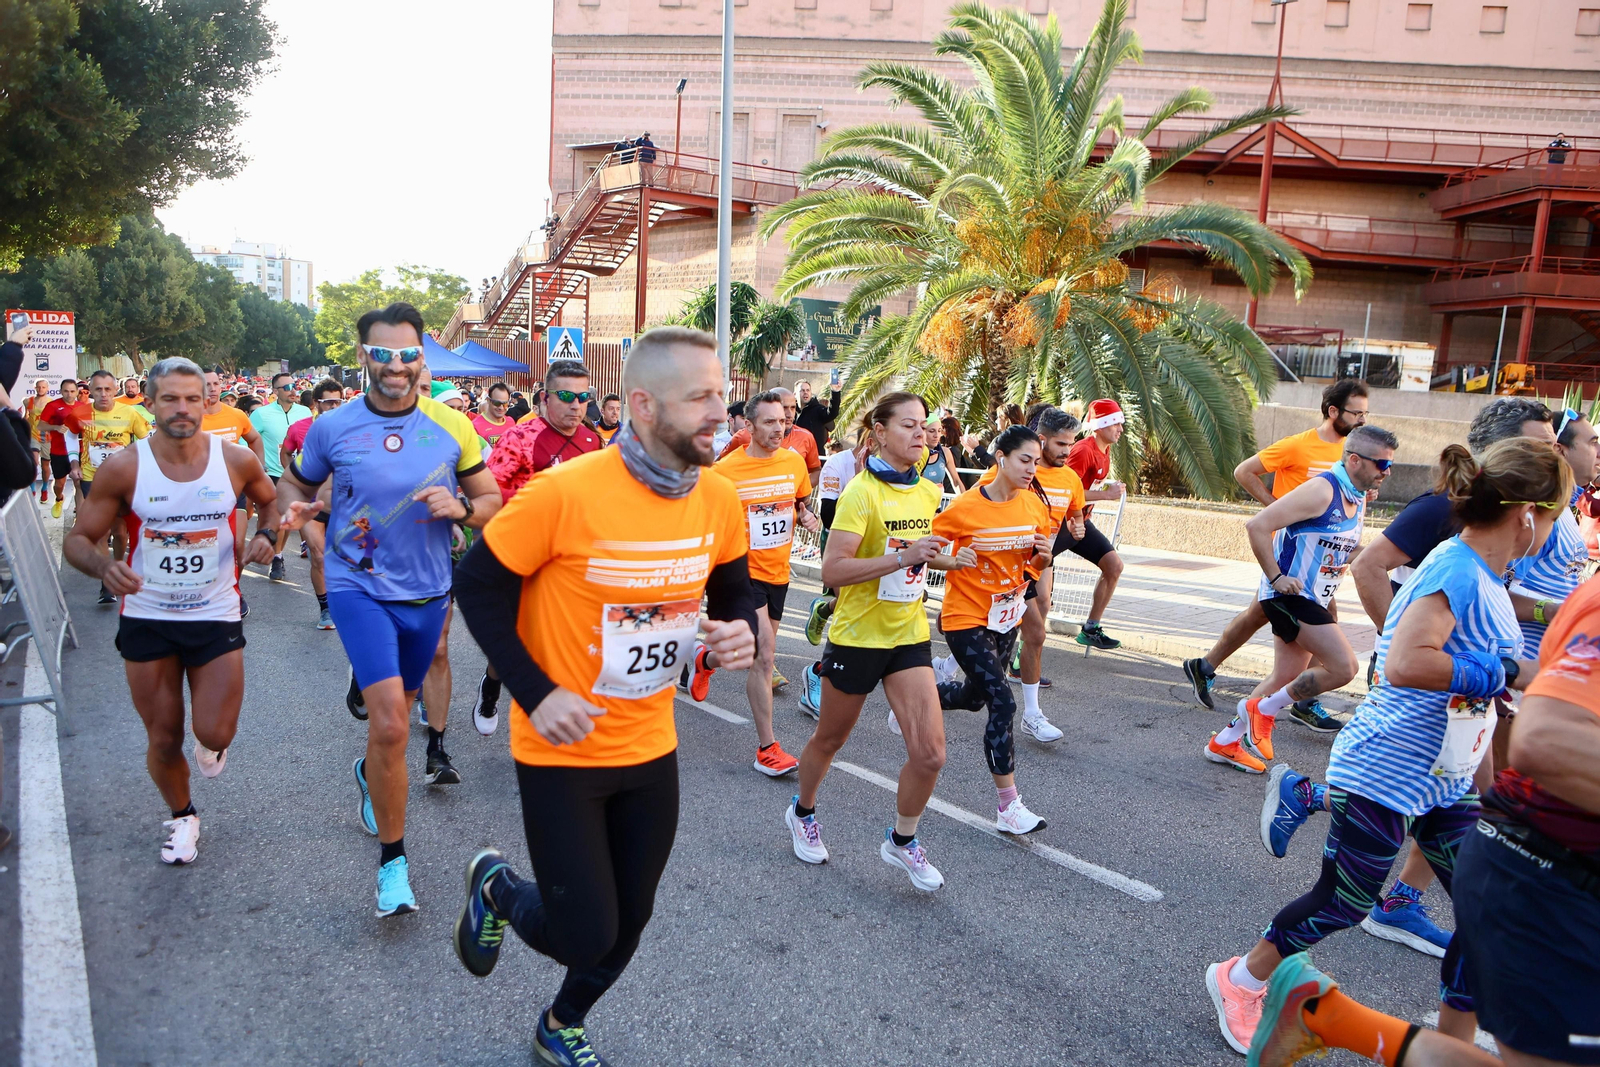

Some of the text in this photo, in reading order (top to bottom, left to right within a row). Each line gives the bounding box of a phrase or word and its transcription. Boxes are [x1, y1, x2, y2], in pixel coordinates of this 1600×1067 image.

[10, 312, 71, 324] ALIDA
[813, 311, 832, 323] Gran
[762, 519, 786, 537] 512
[159, 554, 205, 574] 439
[626, 568, 709, 588] PALMA PALMILLA
[170, 593, 204, 601] RUEDA
[1321, 584, 1340, 597] 52
[627, 640, 679, 675] 258
